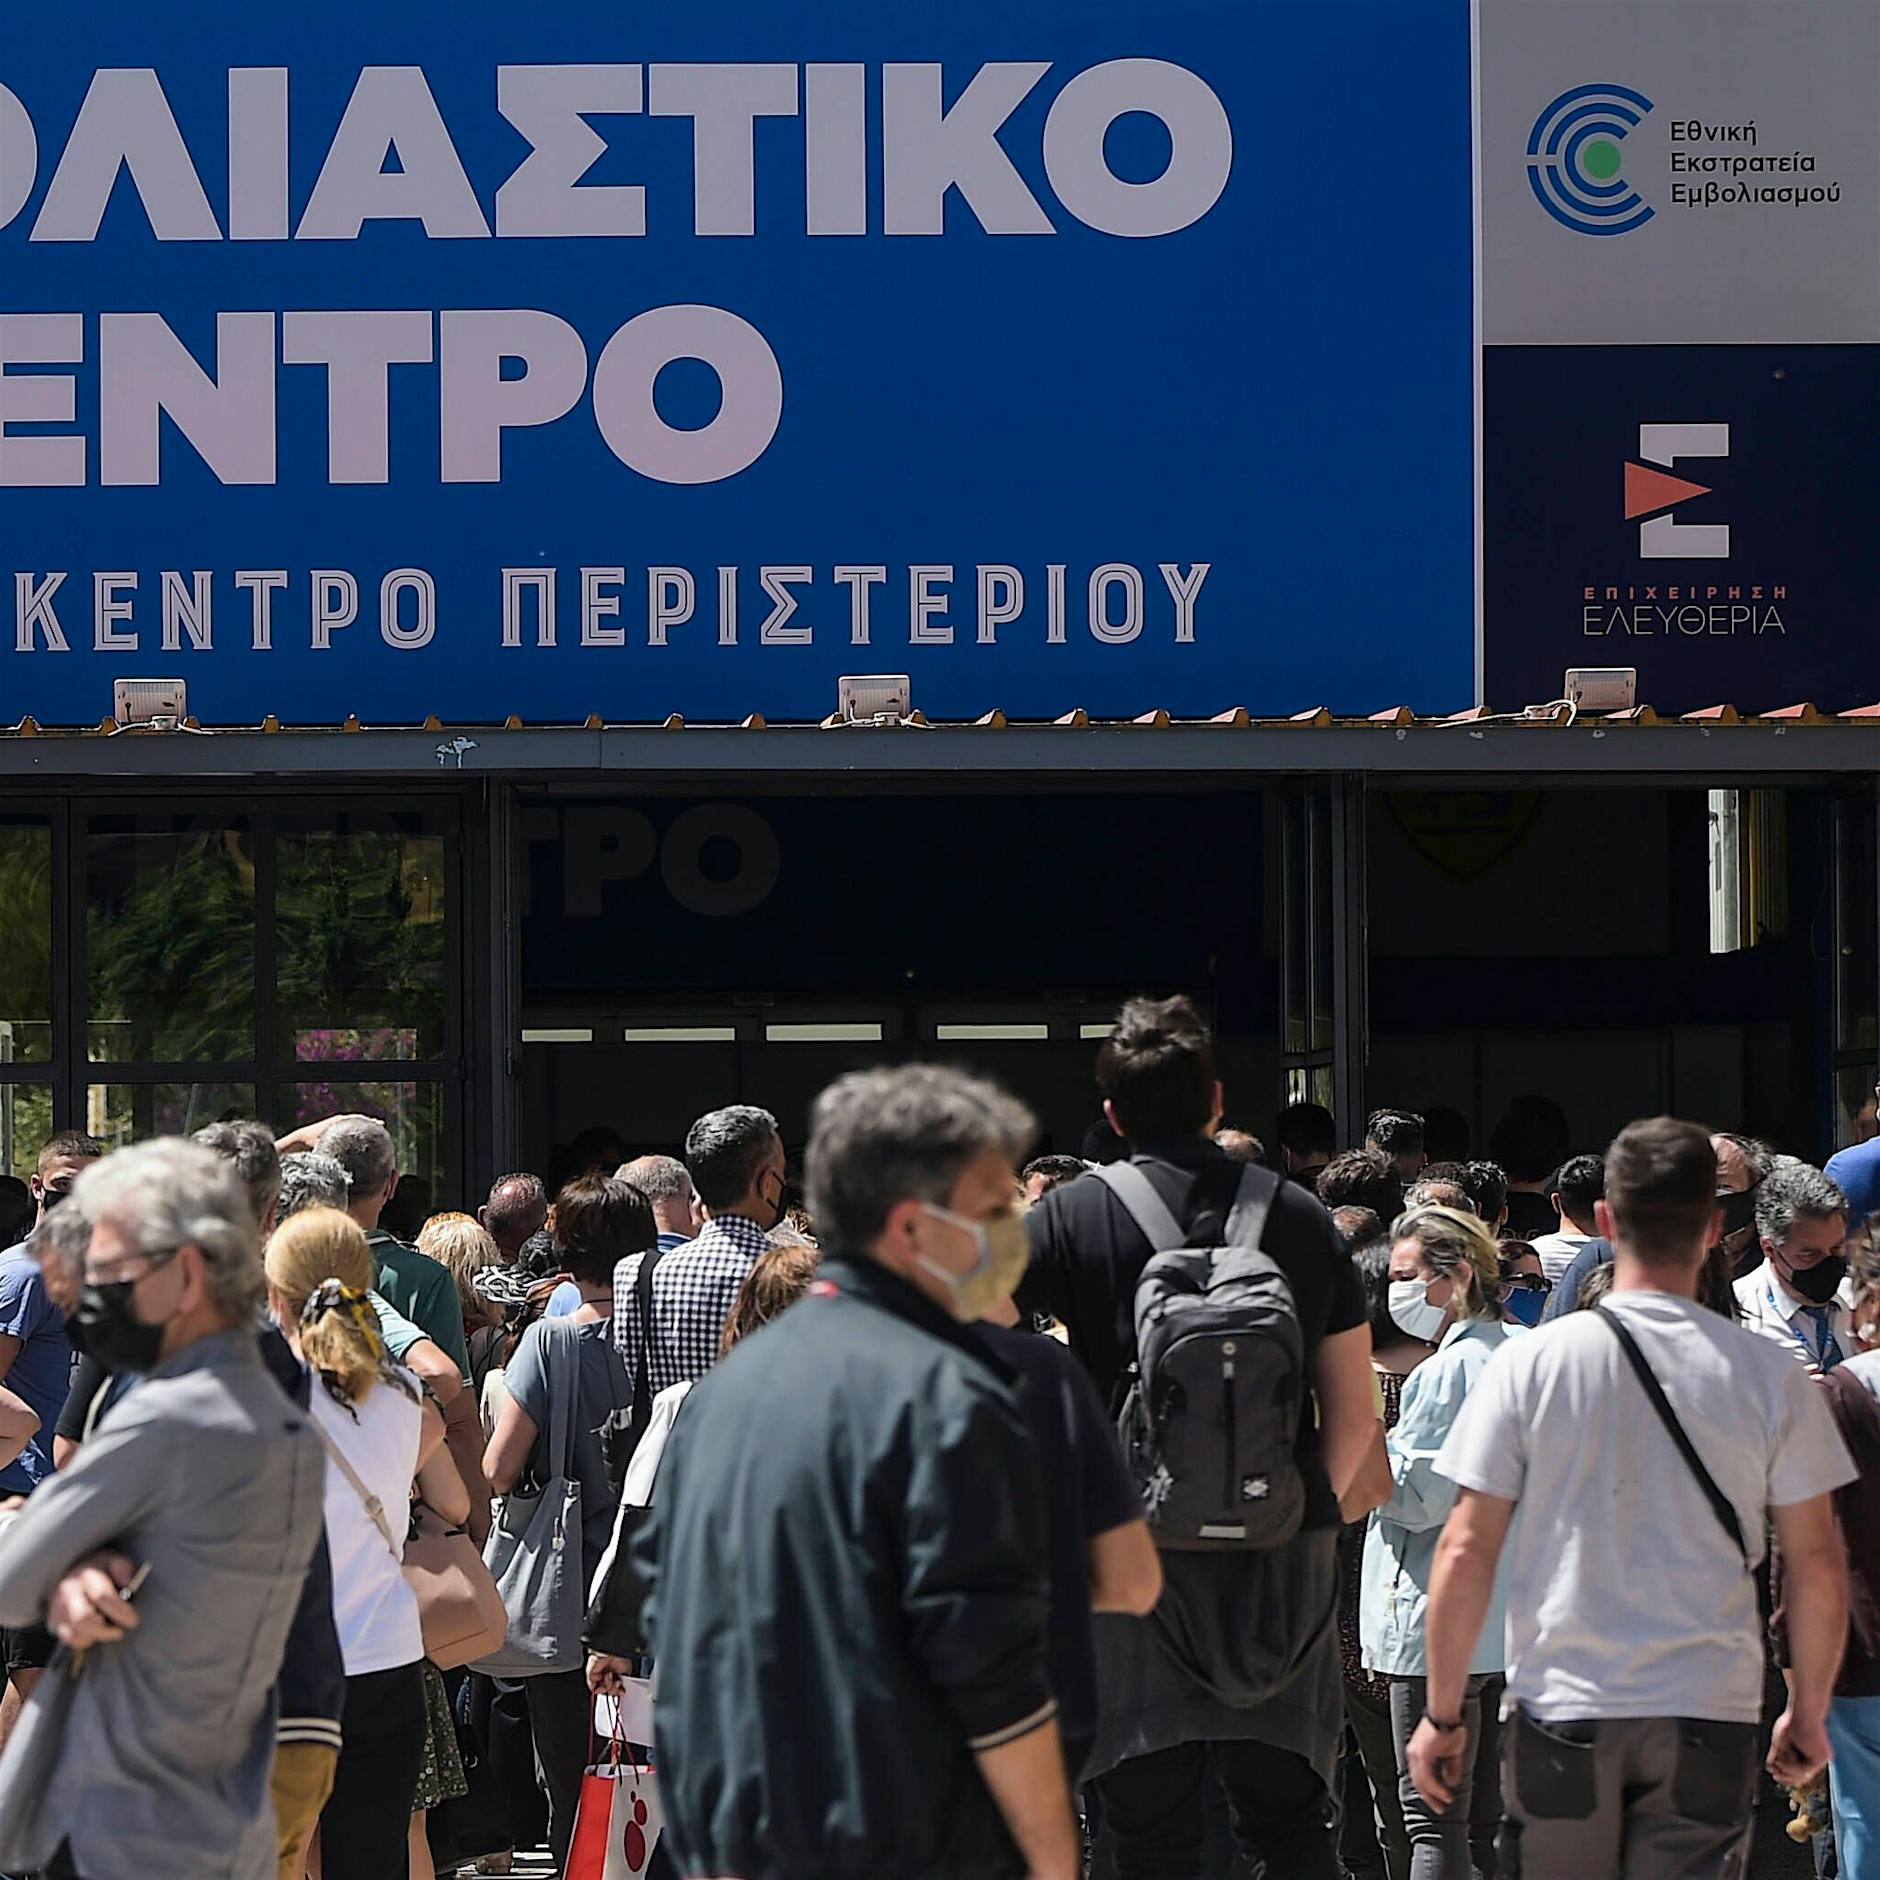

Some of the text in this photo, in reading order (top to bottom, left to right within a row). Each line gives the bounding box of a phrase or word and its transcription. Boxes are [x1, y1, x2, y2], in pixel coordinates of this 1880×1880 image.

[1670, 120, 1757, 145] Εθνική
[0, 57, 1233, 241] ΛΙΑΣΤΙΚΟ
[1670, 151, 1815, 176] Εκστρατεία
[1671, 181, 1841, 207] Εμβολιασμού
[1583, 586, 1787, 600] ΕΠΙΧΕΙΡΗΣΗ
[14, 563, 1211, 652] ΚΕΝΤΡΟ ΠΕΡΙΣΤΕΡΙΟΥ
[1583, 606, 1786, 635] ΕΛΕΥΘΕΡΙΑ
